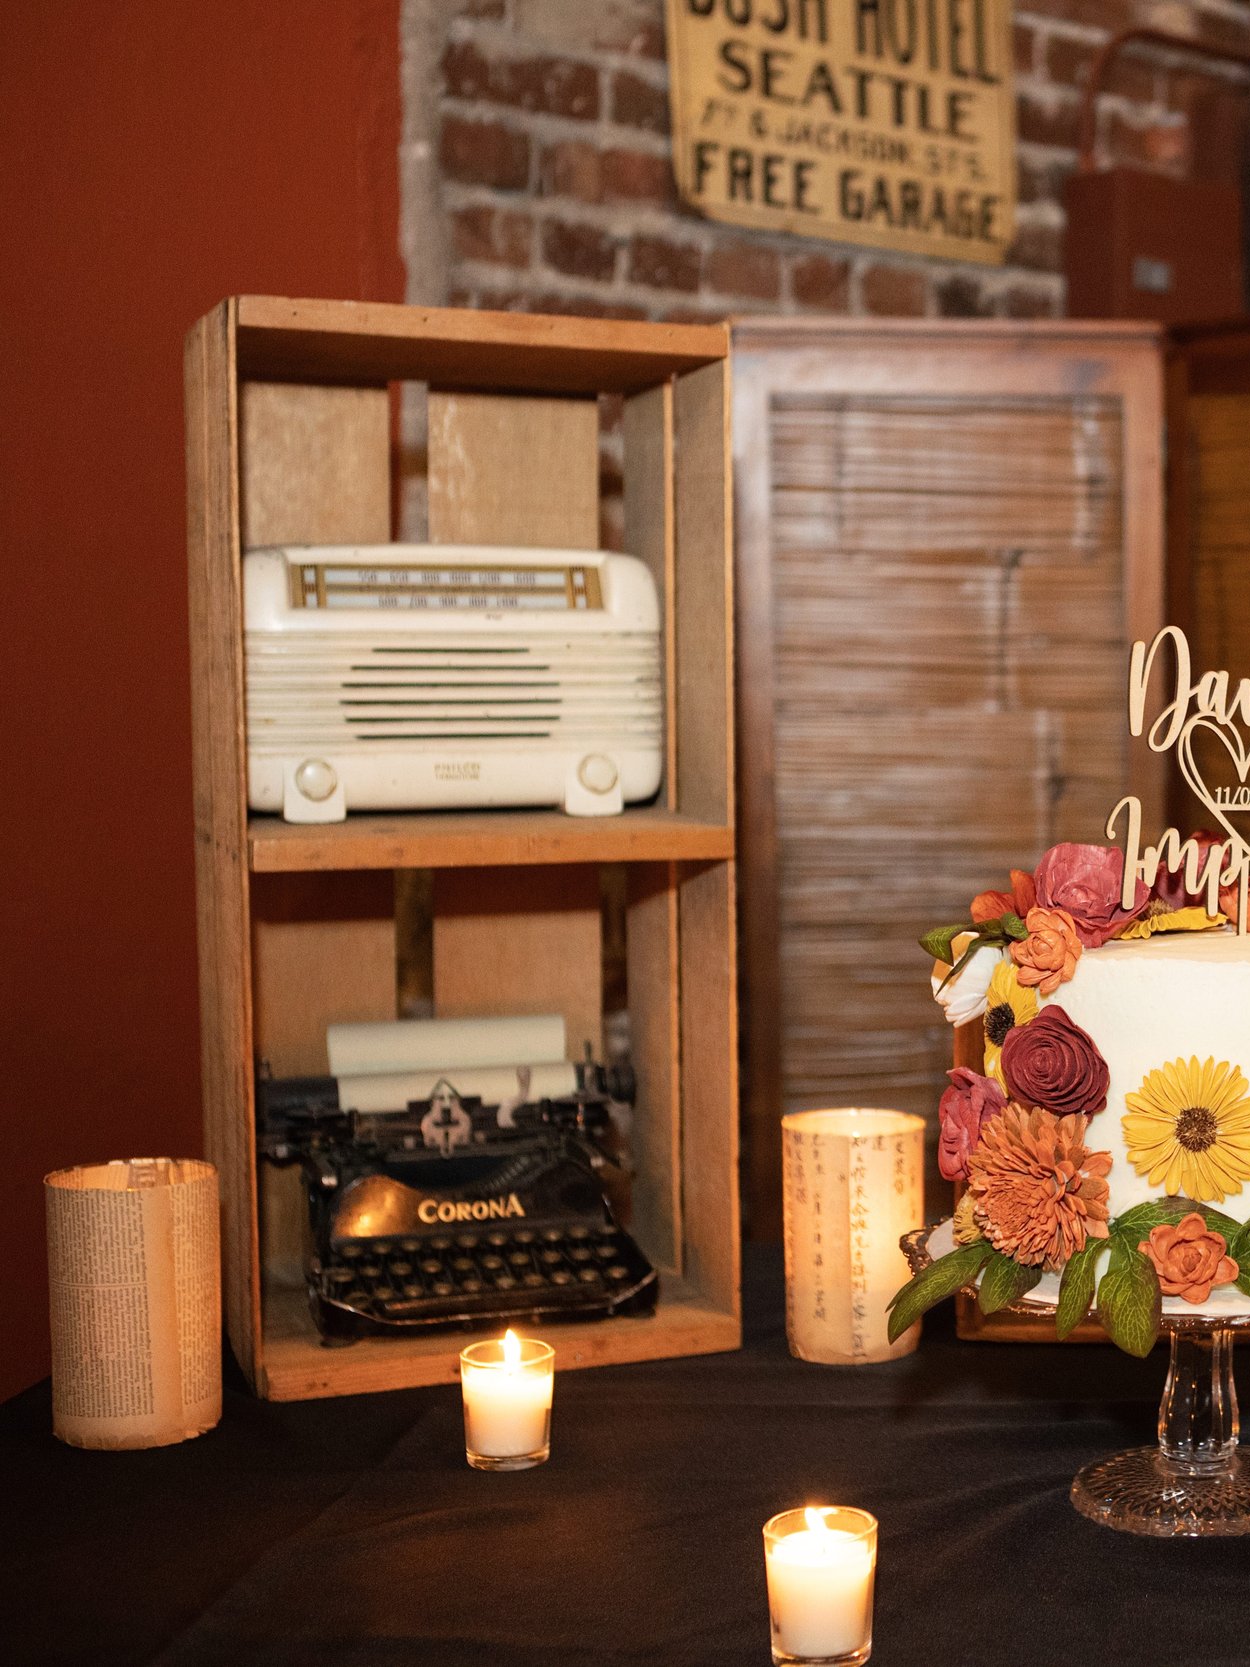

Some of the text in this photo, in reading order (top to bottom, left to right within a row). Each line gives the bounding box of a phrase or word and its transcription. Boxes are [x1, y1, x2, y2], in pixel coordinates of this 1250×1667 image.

[718, 39, 978, 143] SEATTLE
[692, 140, 1002, 244] FREE GARAGE
[418, 1193, 526, 1224] CORONA
